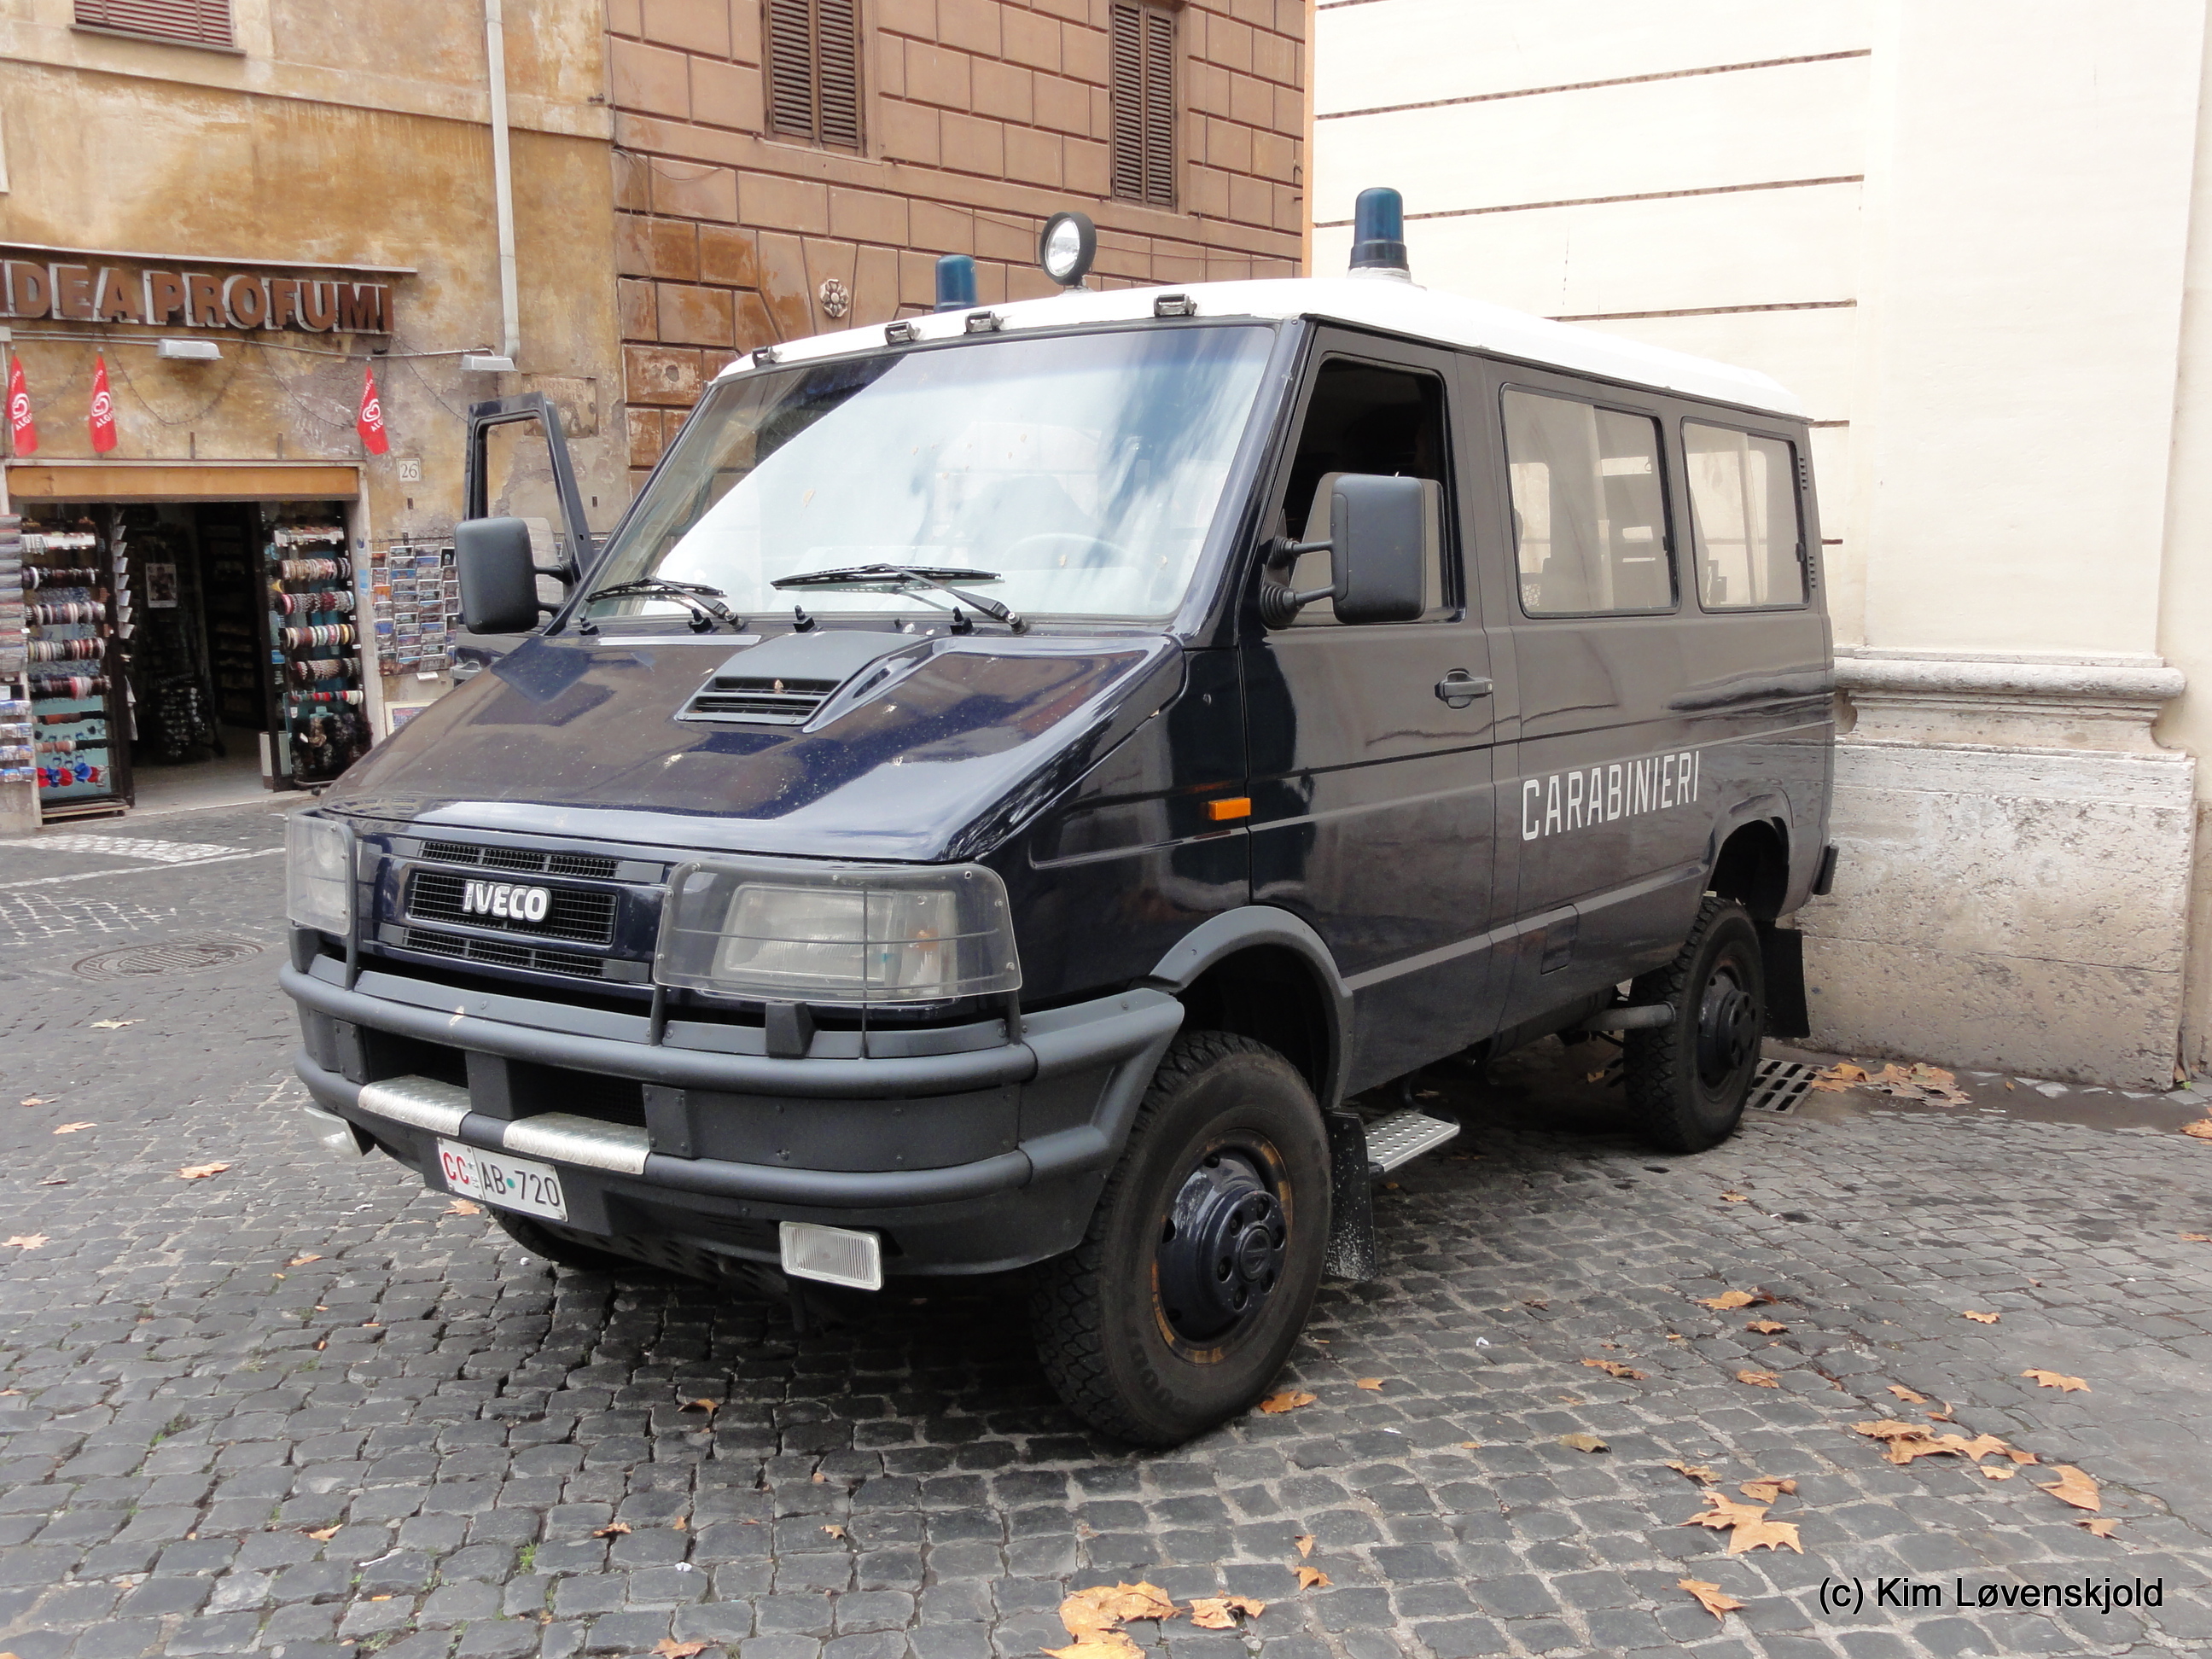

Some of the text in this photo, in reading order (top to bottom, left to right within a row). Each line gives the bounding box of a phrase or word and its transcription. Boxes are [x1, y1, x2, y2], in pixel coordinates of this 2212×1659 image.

[400, 463, 418, 478] 26
[1522, 750, 1700, 841] CARABINIERI
[463, 881, 550, 922] IVECO
